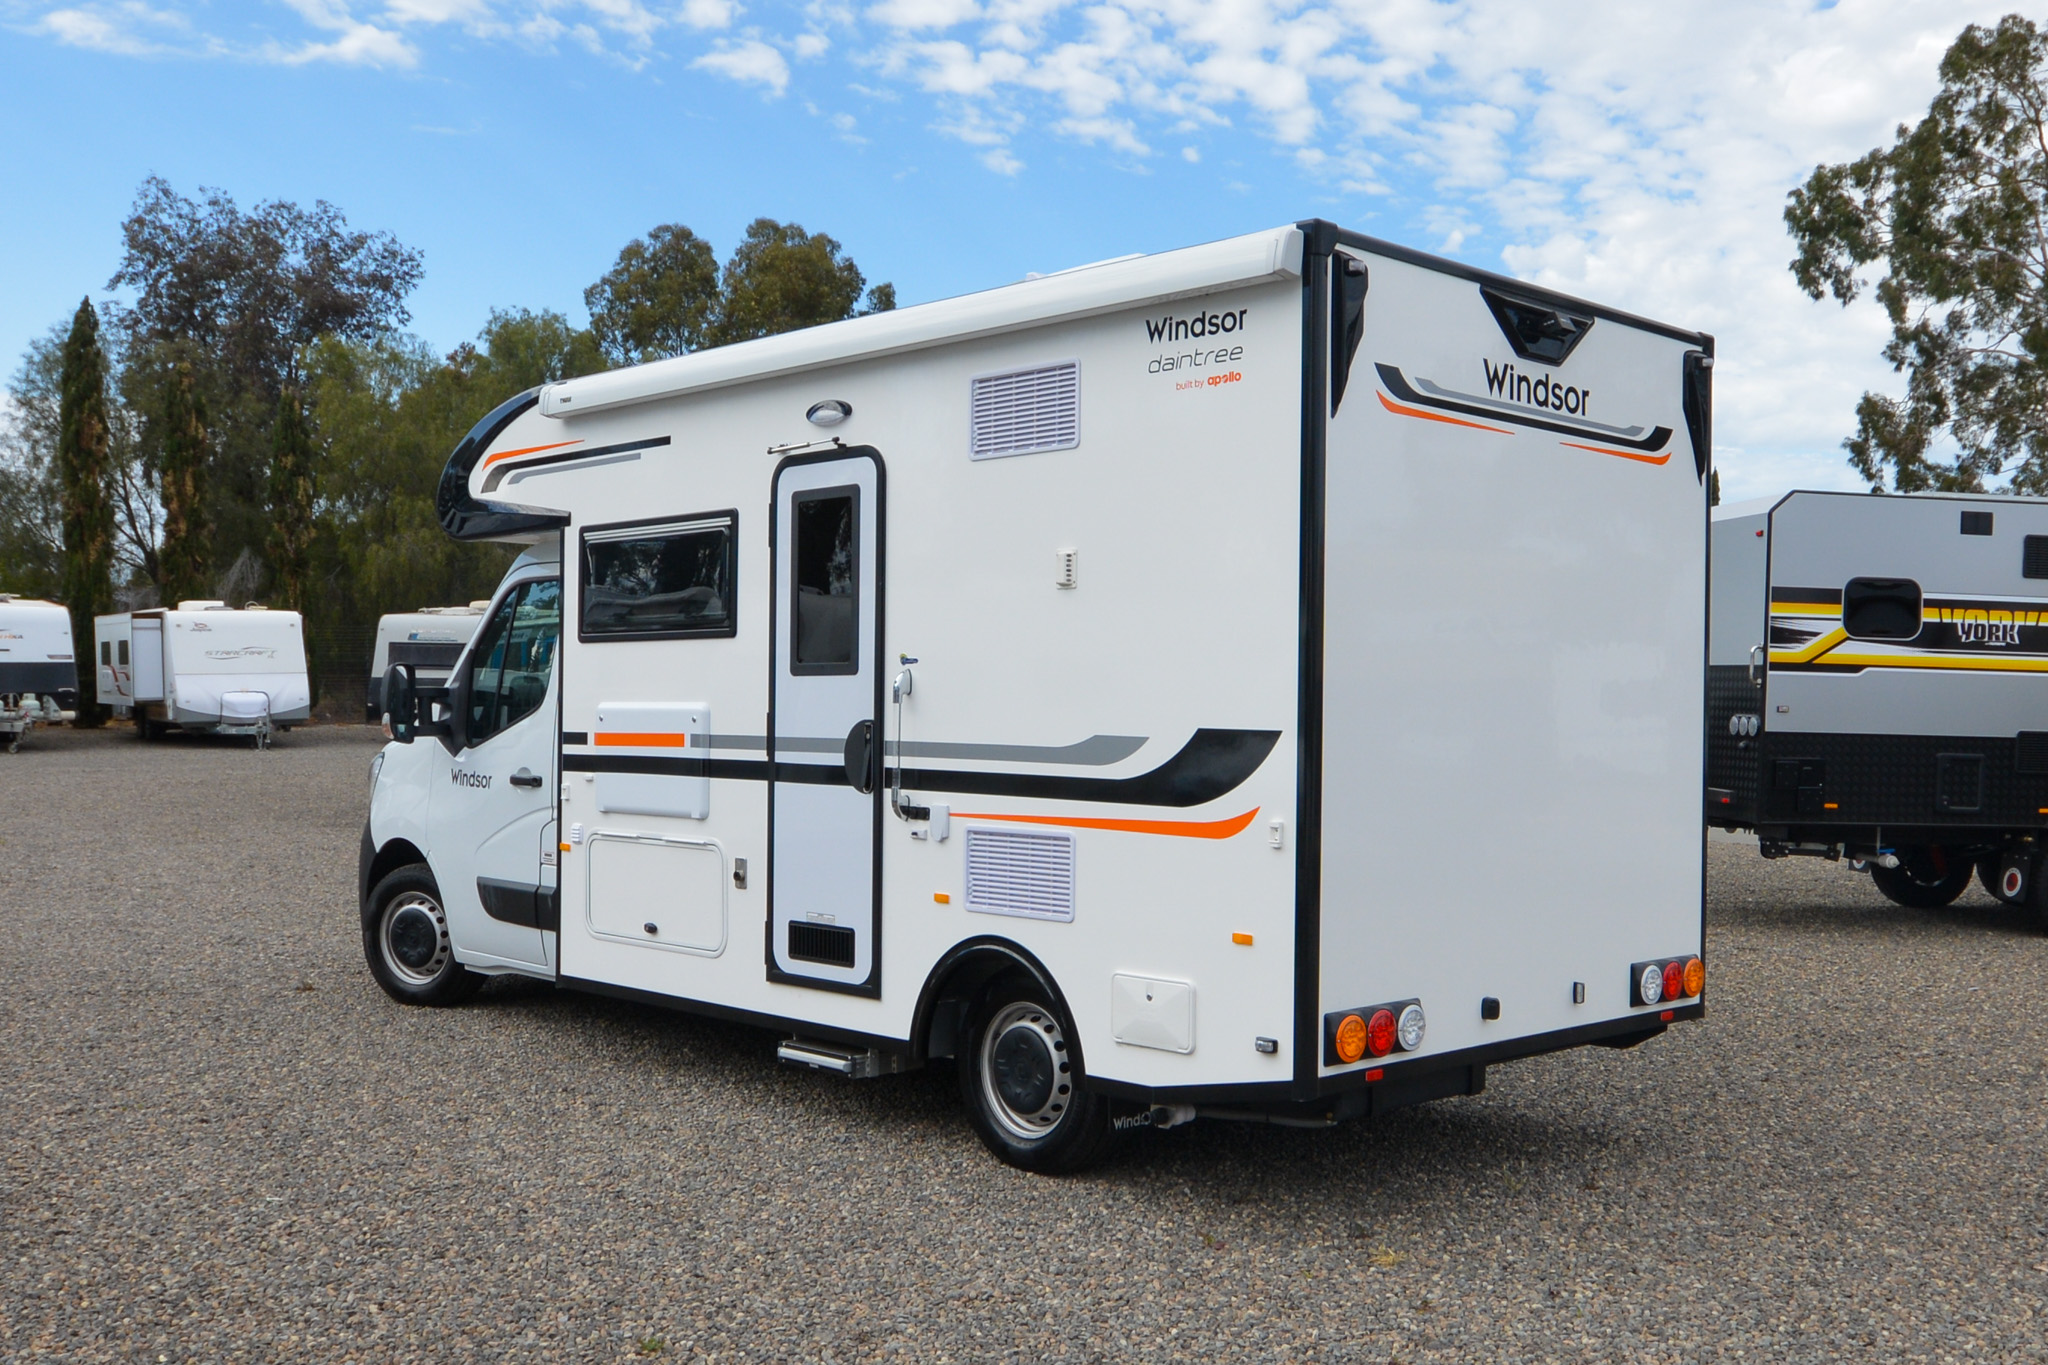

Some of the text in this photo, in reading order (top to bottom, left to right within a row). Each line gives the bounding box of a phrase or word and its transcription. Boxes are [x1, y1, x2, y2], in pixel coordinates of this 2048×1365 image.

[1146, 309, 1247, 344] Windsor
[1148, 346, 1243, 373] daintree
[1176, 371, 1242, 391] built by apollo
[1483, 358, 1590, 416] Windsor
[1957, 622, 2020, 645] YORK
[451, 768, 492, 789] Windsor
